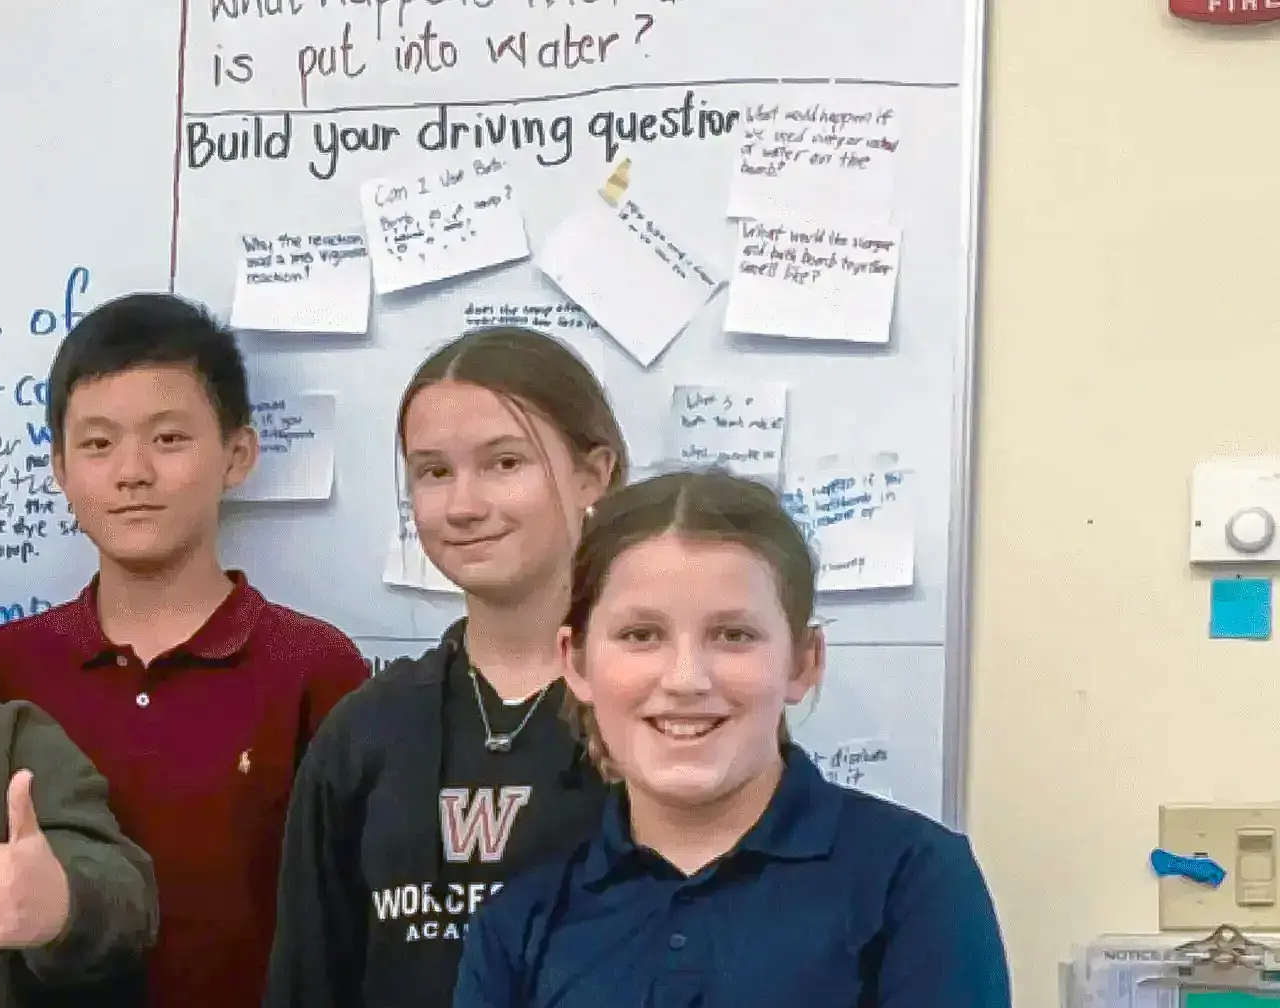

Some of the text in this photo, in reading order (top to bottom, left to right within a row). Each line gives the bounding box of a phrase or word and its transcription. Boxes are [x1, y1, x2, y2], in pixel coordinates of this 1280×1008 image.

[215, 44, 254, 87] is
[299, 21, 367, 107] put
[396, 20, 458, 73] into
[184, 112, 291, 168] Build
[310, 121, 400, 179] your
[420, 104, 573, 166] driving
[30, 267, 89, 337] of
[439, 786, 532, 863] W
